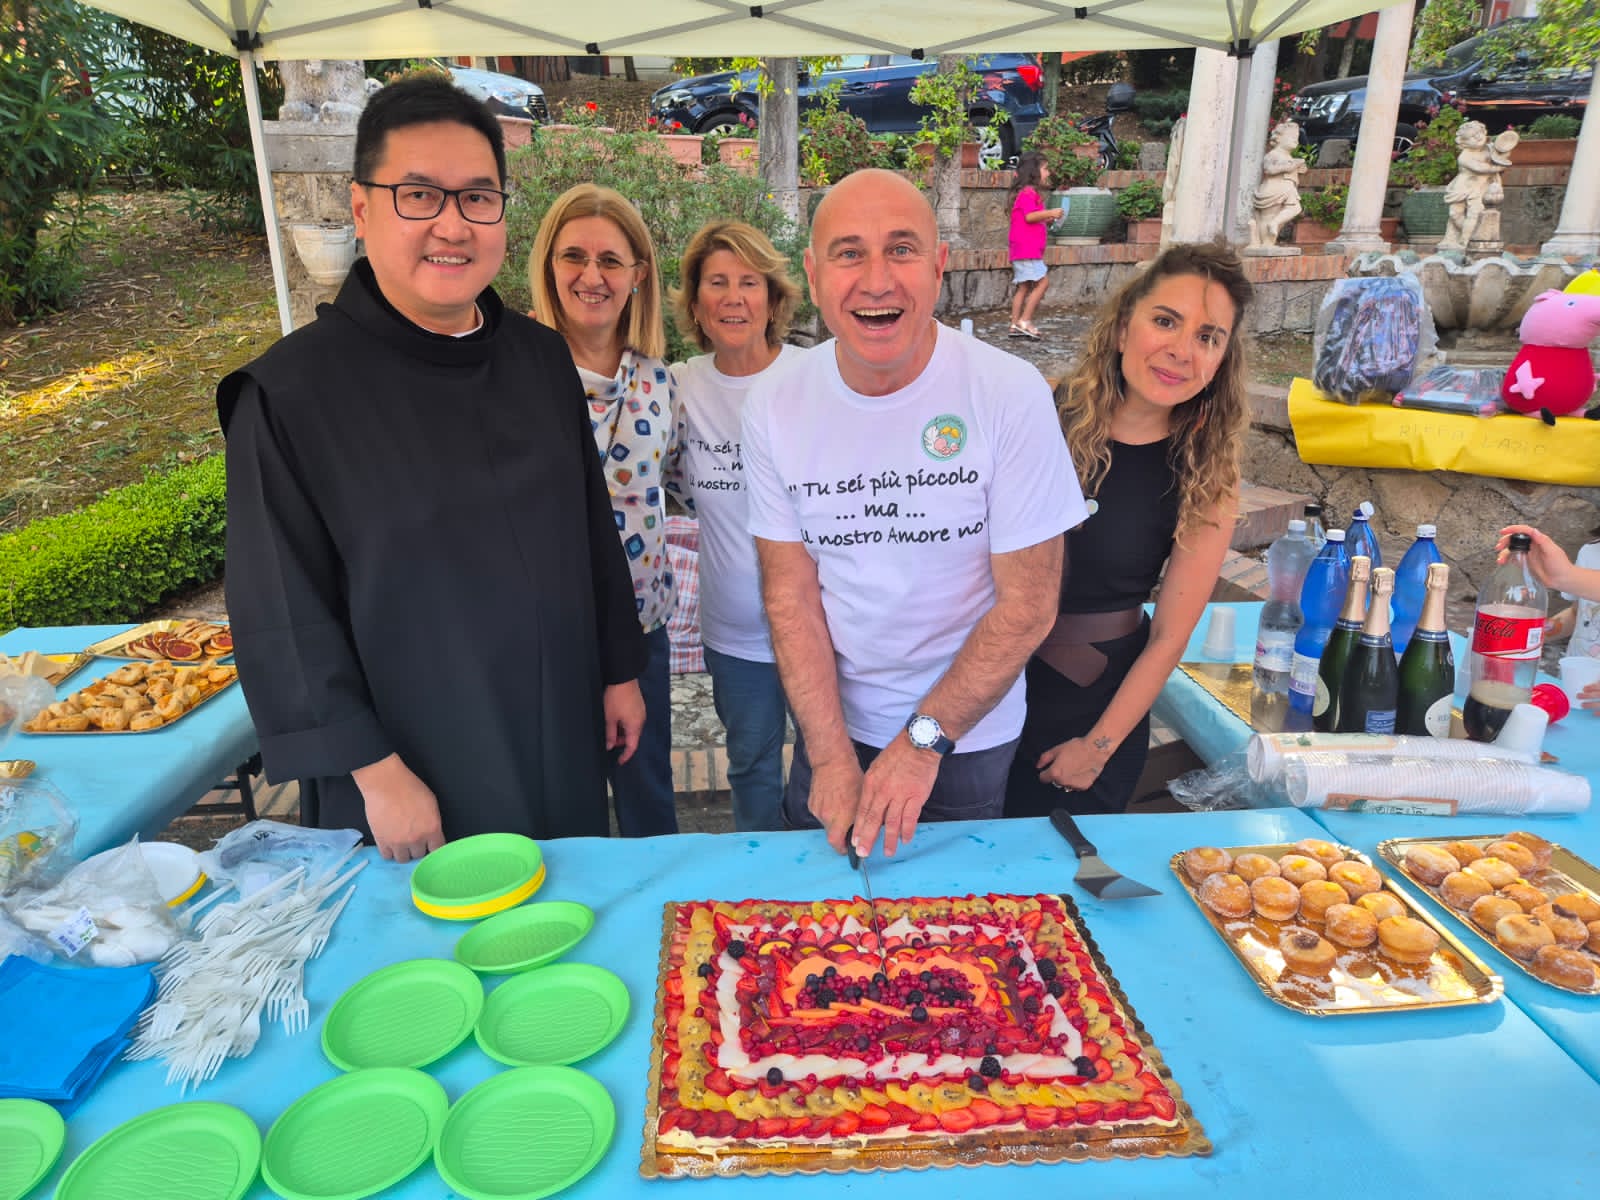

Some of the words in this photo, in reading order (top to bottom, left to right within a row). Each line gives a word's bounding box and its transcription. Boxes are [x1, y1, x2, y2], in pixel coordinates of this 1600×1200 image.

[697, 479, 740, 491] nostro
[801, 482, 831, 497] Tu
[836, 473, 865, 494] sei
[869, 470, 902, 496] più
[905, 466, 979, 494] piccolo
[864, 502, 899, 518] ma
[818, 528, 882, 546] nostro
[887, 526, 950, 545] Amore
